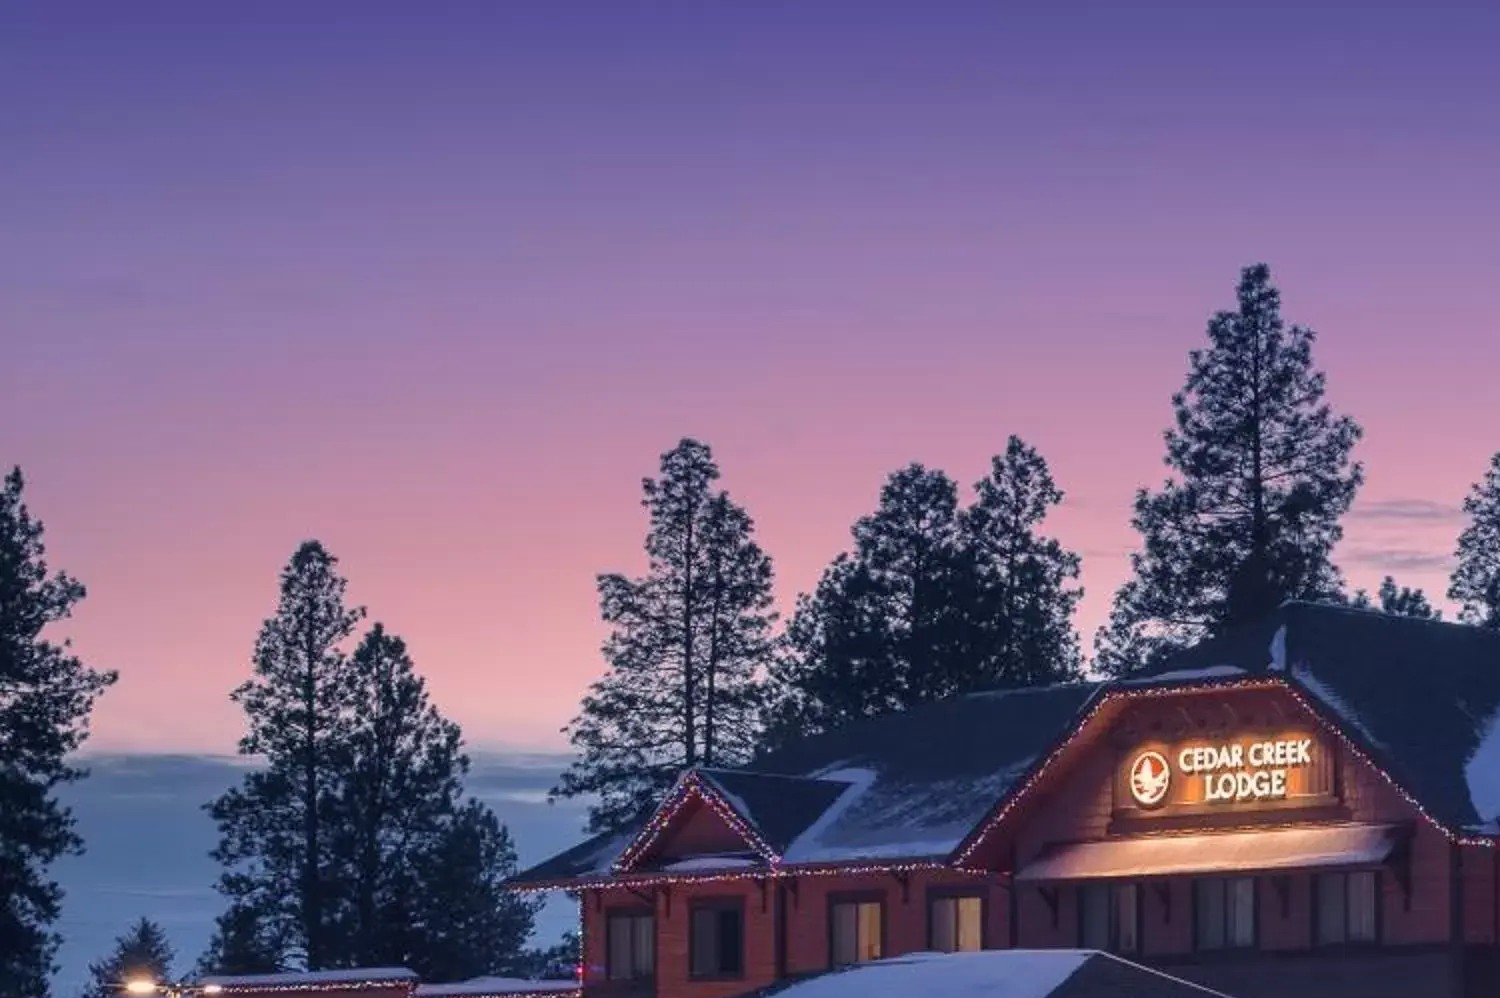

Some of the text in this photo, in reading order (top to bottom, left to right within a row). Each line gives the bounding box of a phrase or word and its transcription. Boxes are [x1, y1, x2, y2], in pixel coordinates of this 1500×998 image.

[1178, 739, 1312, 773] CEDAR CREEK
[1205, 769, 1286, 801] LODGE
